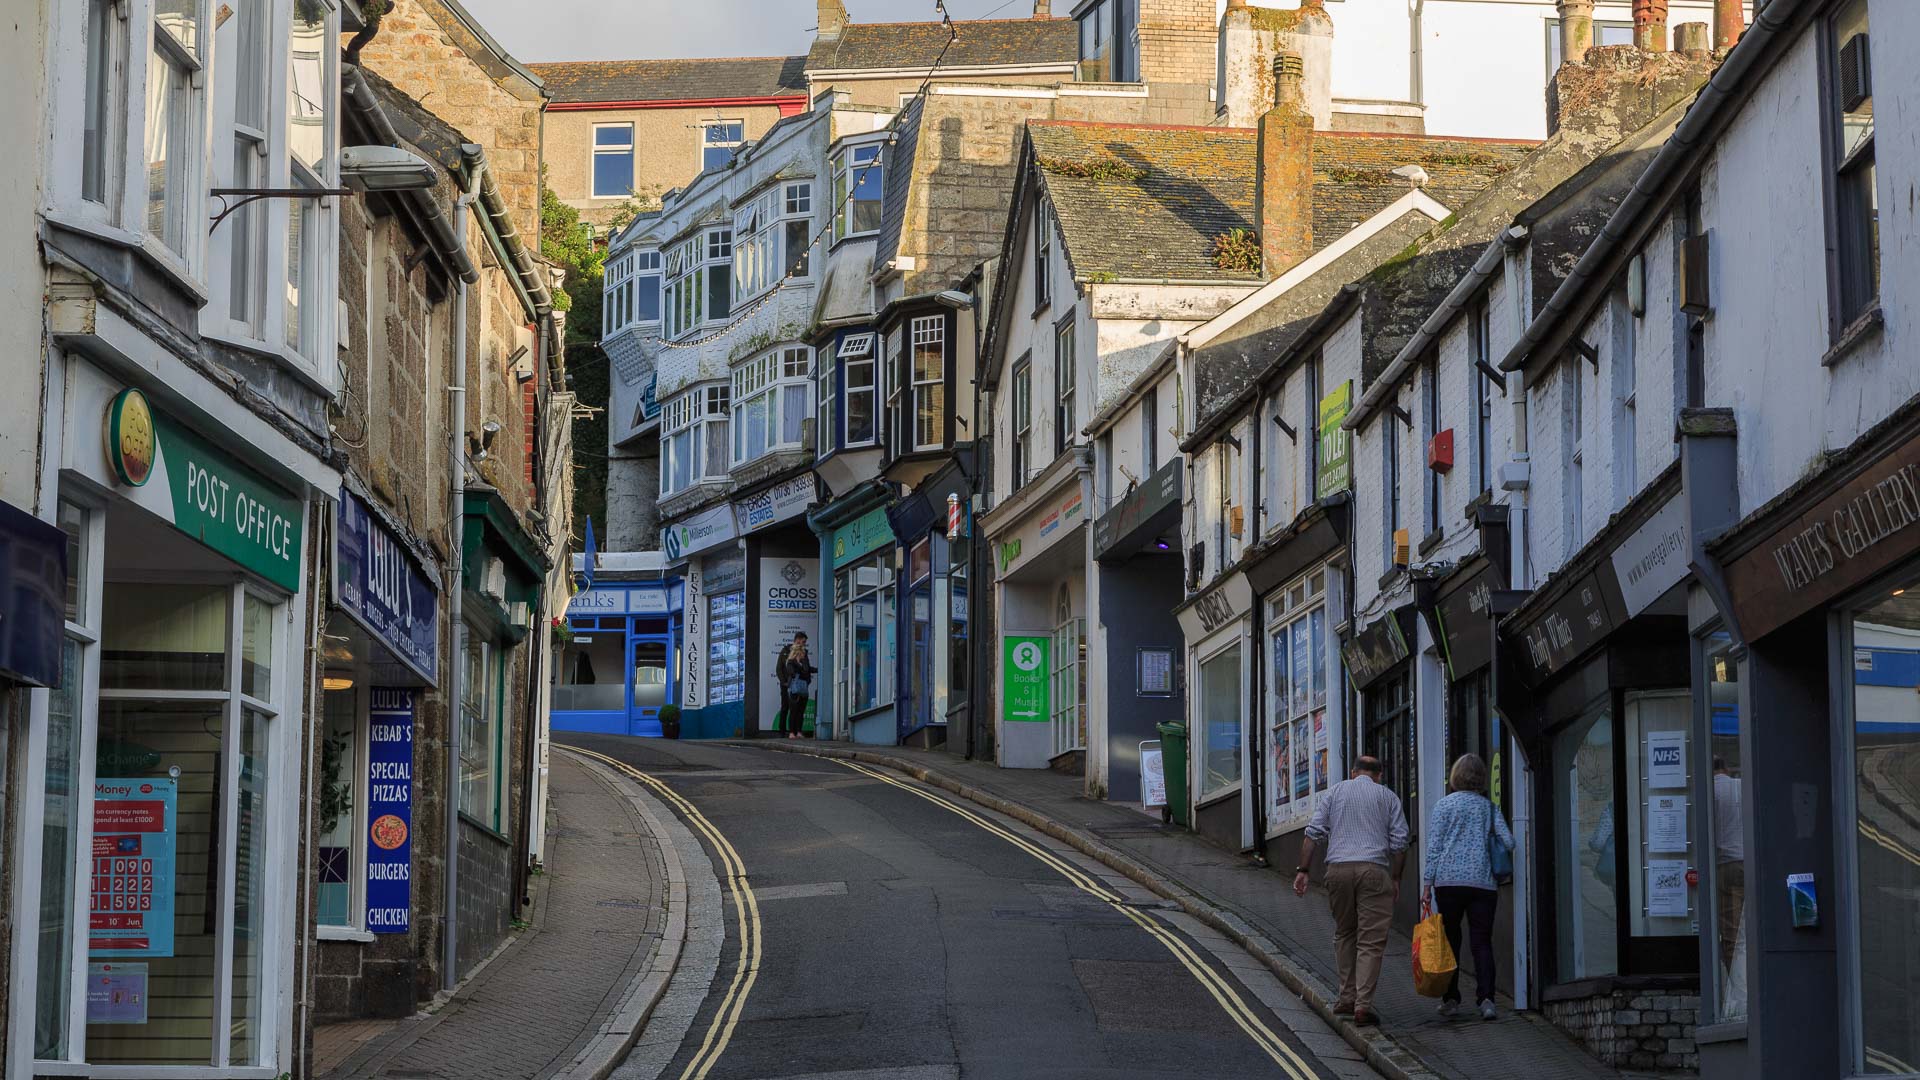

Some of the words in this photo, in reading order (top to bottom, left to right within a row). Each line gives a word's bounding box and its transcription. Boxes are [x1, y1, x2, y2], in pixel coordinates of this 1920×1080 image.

[1332, 429, 1347, 461] LET
[747, 492, 772, 511] CROSS
[187, 460, 229, 524] POST
[235, 492, 291, 561] OFFICE
[750, 505, 774, 526] ESTATES
[1772, 521, 1834, 593] WAVES
[1833, 463, 1920, 559] GALLERY
[768, 587, 817, 599] CROSS
[689, 572, 699, 634] ESTATE
[768, 599, 817, 609] ESTATES
[366, 601, 384, 630] BURGERS
[400, 629, 415, 657] CHICKEN
[418, 648, 431, 671] PIZZAS
[687, 641, 698, 703] AGENTS
[1014, 673, 1040, 684] Books
[1014, 698, 1040, 707] Music
[1654, 750, 1680, 762] NHS
[370, 762, 410, 780] SPECIAL
[95, 784, 132, 797] Money
[373, 785, 408, 802] PIZZAS
[368, 863, 409, 880] BURGERS
[126, 918, 140, 926] Jun
[368, 908, 408, 925] CHICKEN
